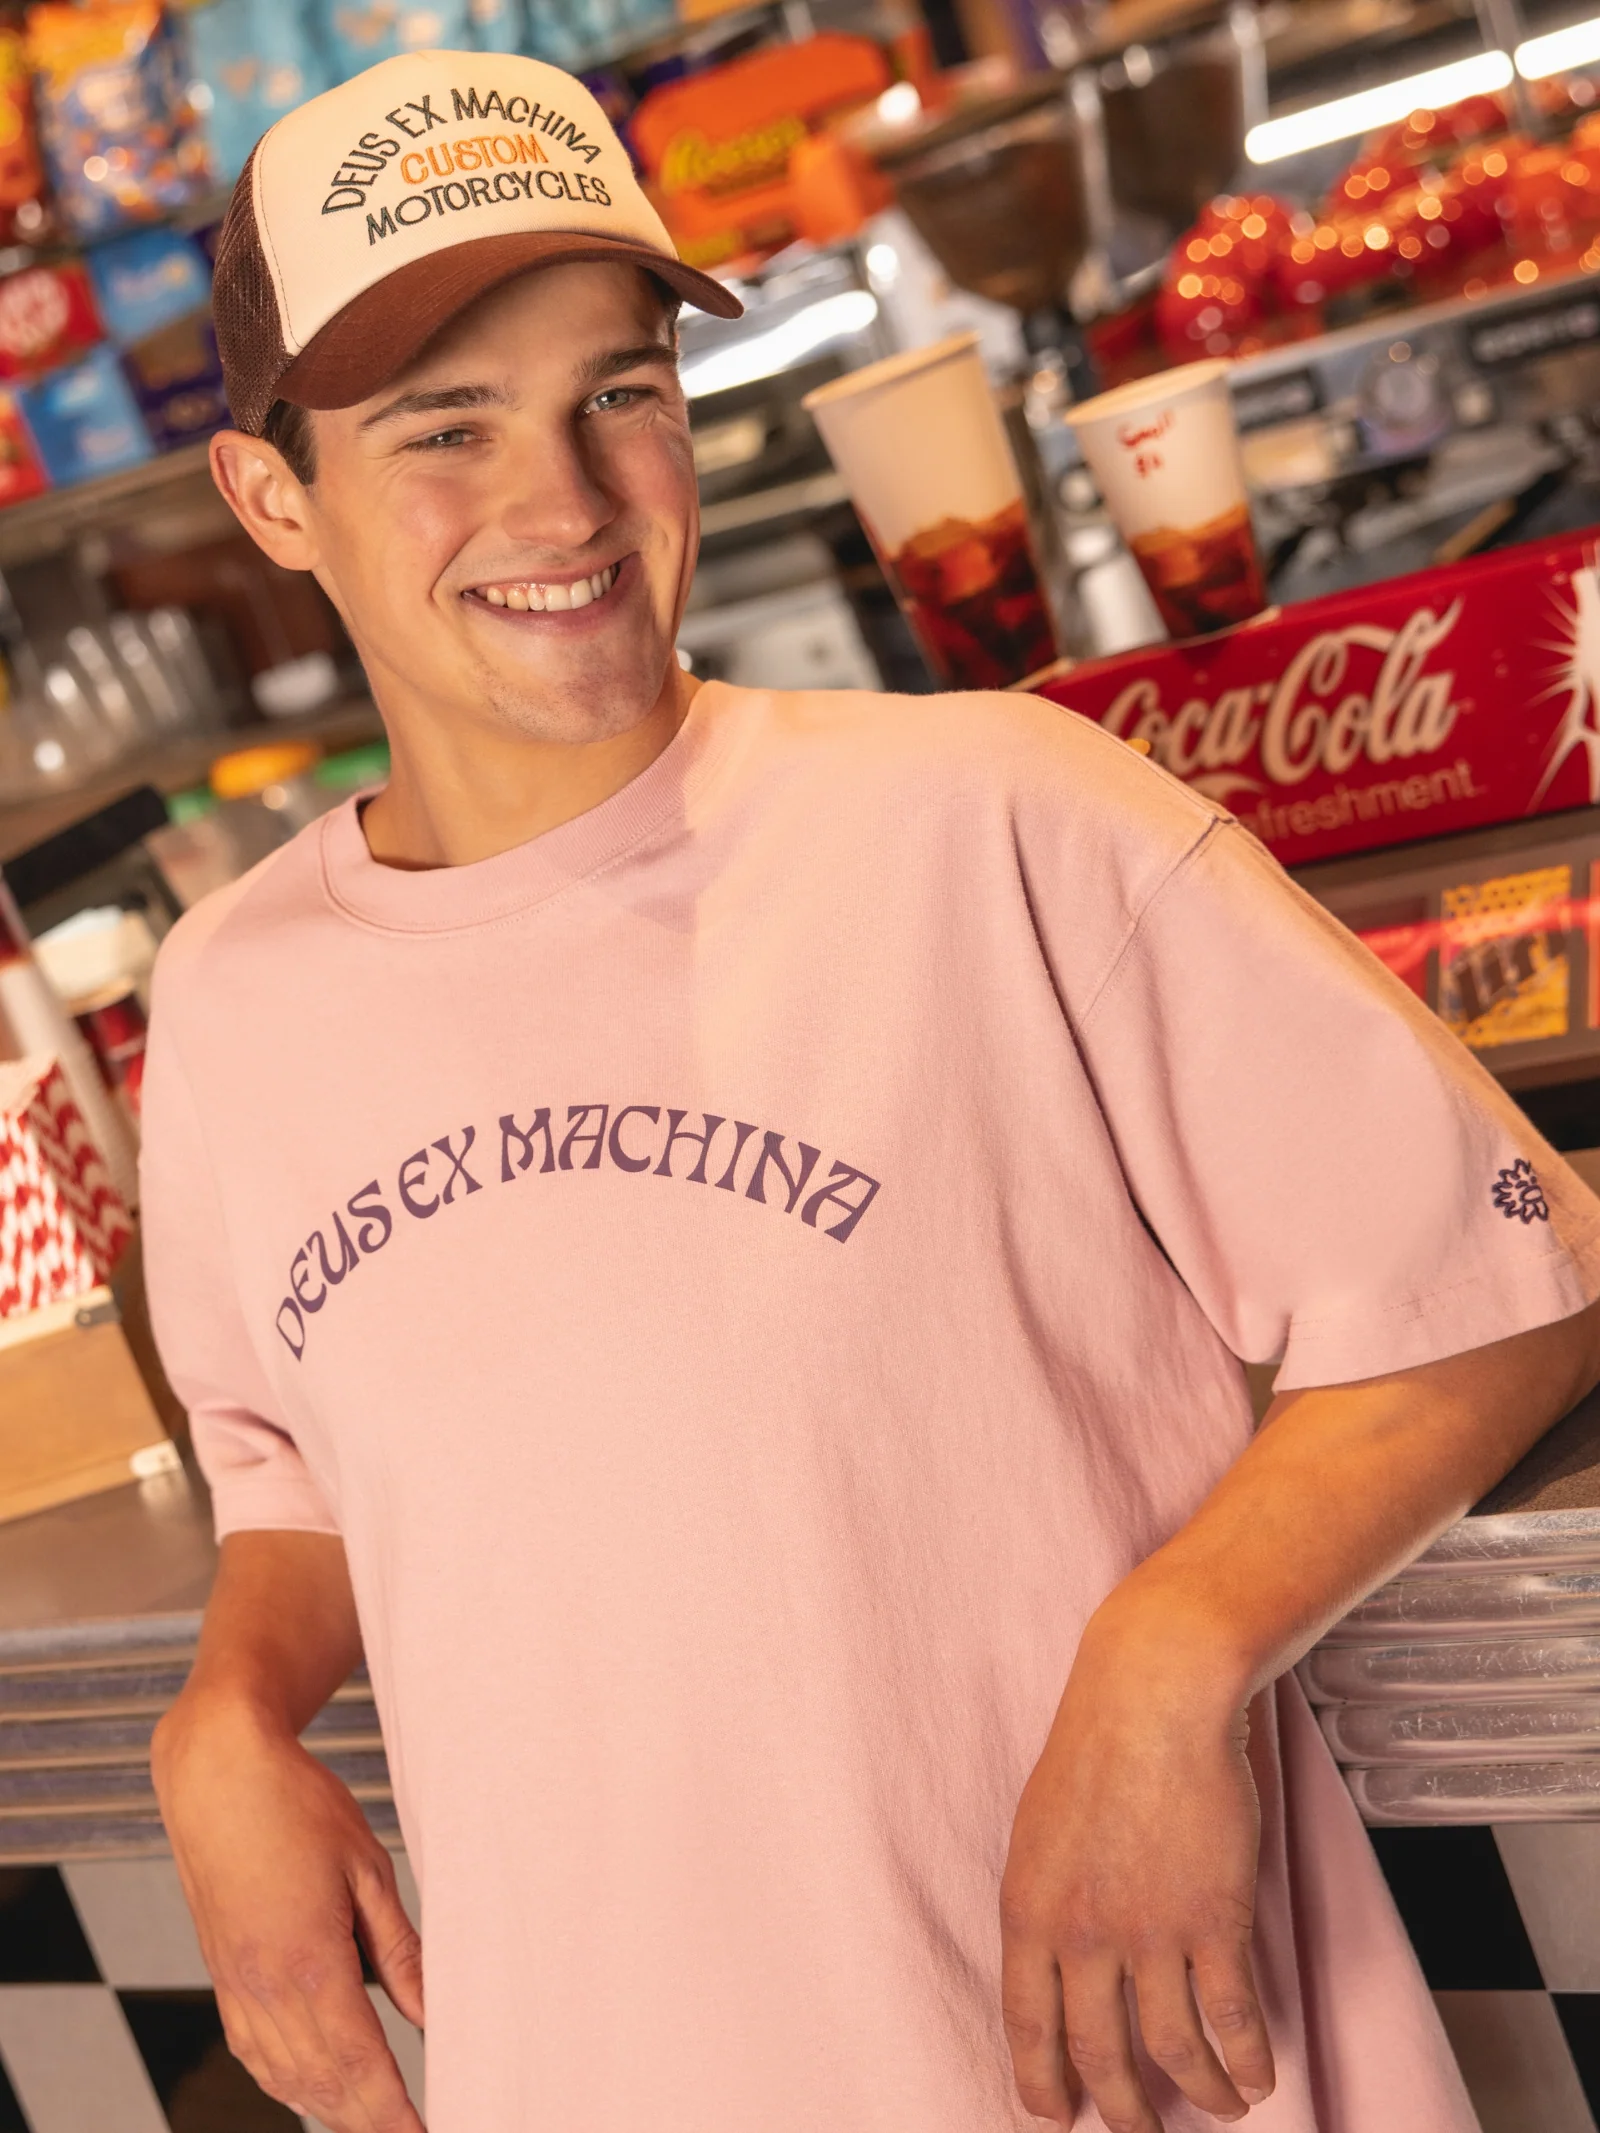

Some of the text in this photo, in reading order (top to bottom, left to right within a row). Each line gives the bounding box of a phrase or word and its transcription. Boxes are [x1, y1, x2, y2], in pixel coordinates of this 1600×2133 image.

[321, 132, 400, 215] DEUS
[385, 94, 448, 139] EX
[450, 87, 602, 164] MACHINA
[400, 133, 549, 185] CUSTOM
[366, 170, 612, 245] MOTORCYCLES
[276, 1104, 882, 1362] DEUS EX MACHINA
